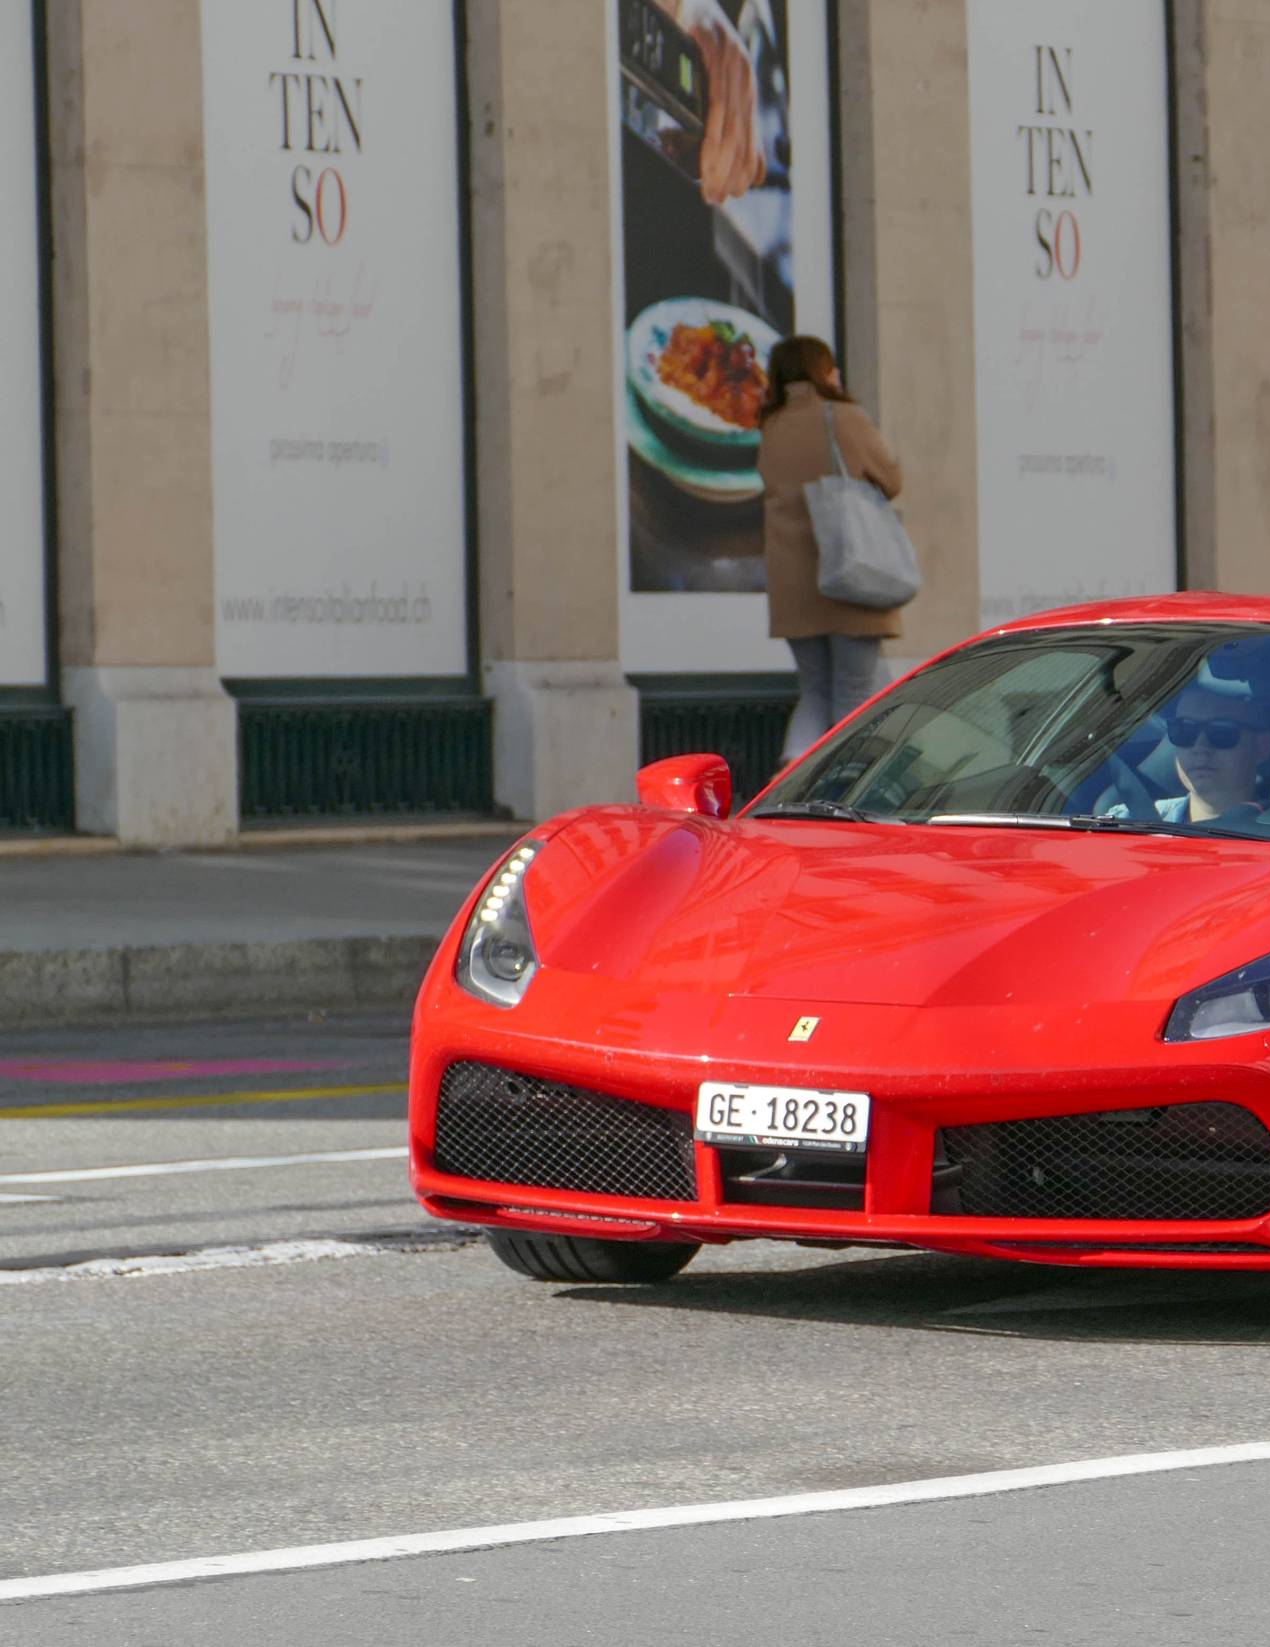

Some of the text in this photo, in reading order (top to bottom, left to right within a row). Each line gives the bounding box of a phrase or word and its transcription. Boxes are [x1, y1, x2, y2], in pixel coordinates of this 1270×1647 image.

[290, 0, 338, 61] IN
[269, 72, 364, 155] TEN
[1034, 45, 1073, 117] IN
[1017, 125, 1093, 199] TEN
[290, 165, 348, 245] SO
[1034, 210, 1082, 281] SO
